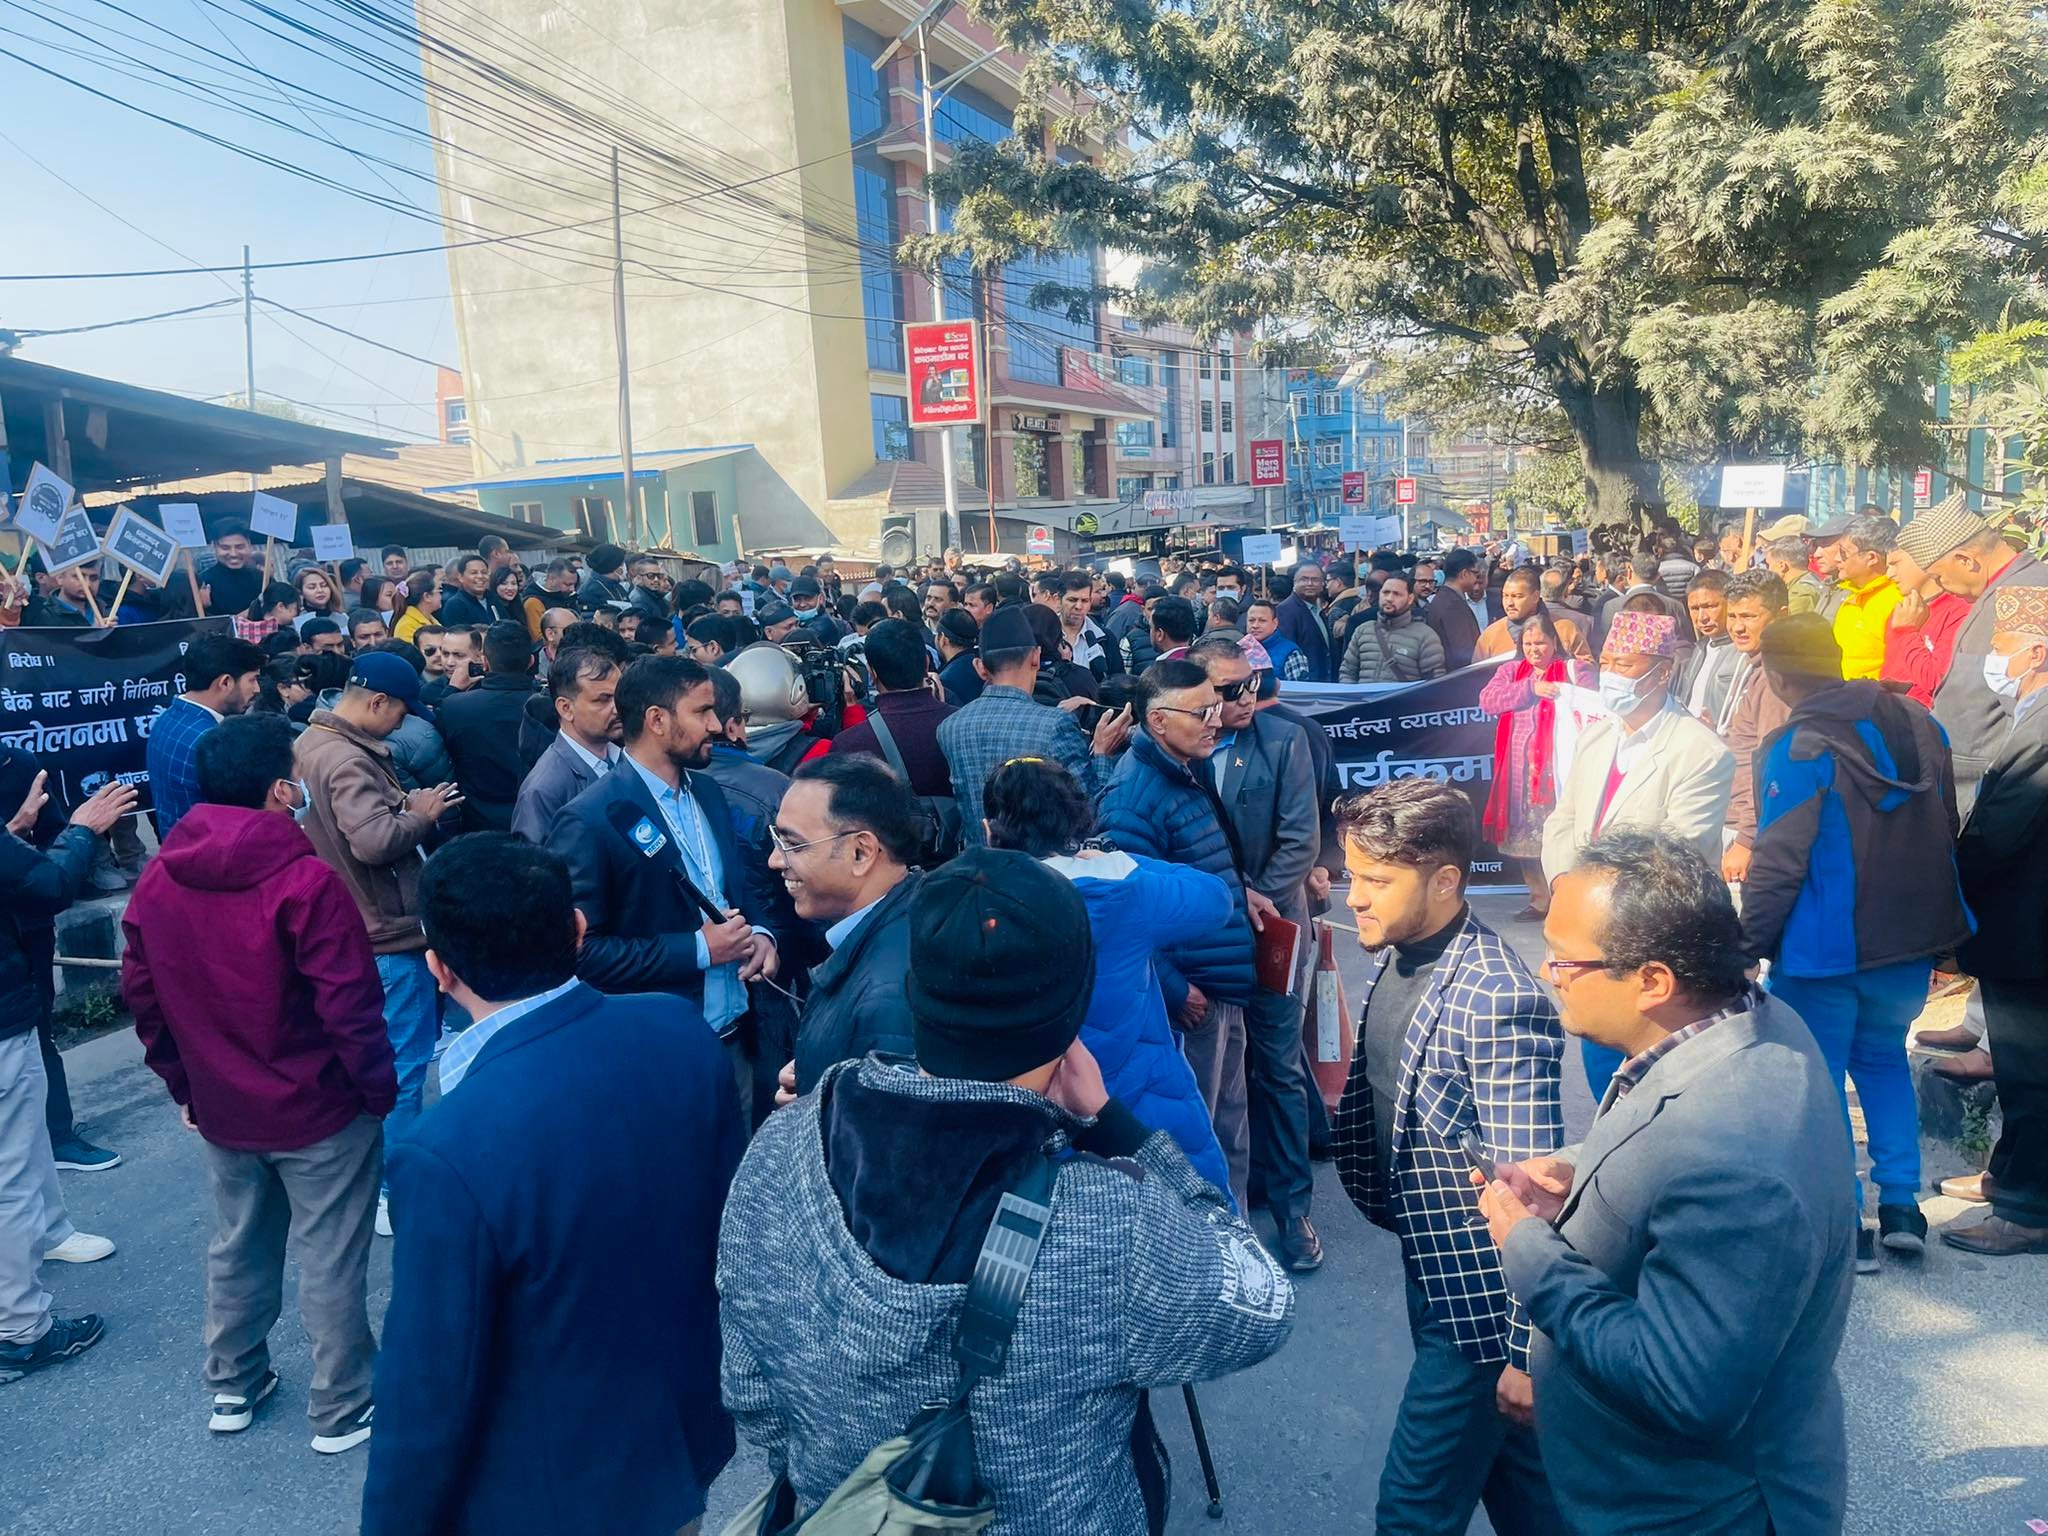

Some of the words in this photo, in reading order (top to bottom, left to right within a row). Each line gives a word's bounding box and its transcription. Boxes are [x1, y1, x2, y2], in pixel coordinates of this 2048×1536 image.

[1257, 471, 1279, 479] Desh
[1, 687, 34, 712] बैंक
[40, 690, 72, 708] बाट
[78, 682, 116, 706] जारी
[122, 678, 169, 701] नितिका
[0, 720, 128, 753] न्दोलनमा
[1323, 718, 1392, 740] वाईल्स
